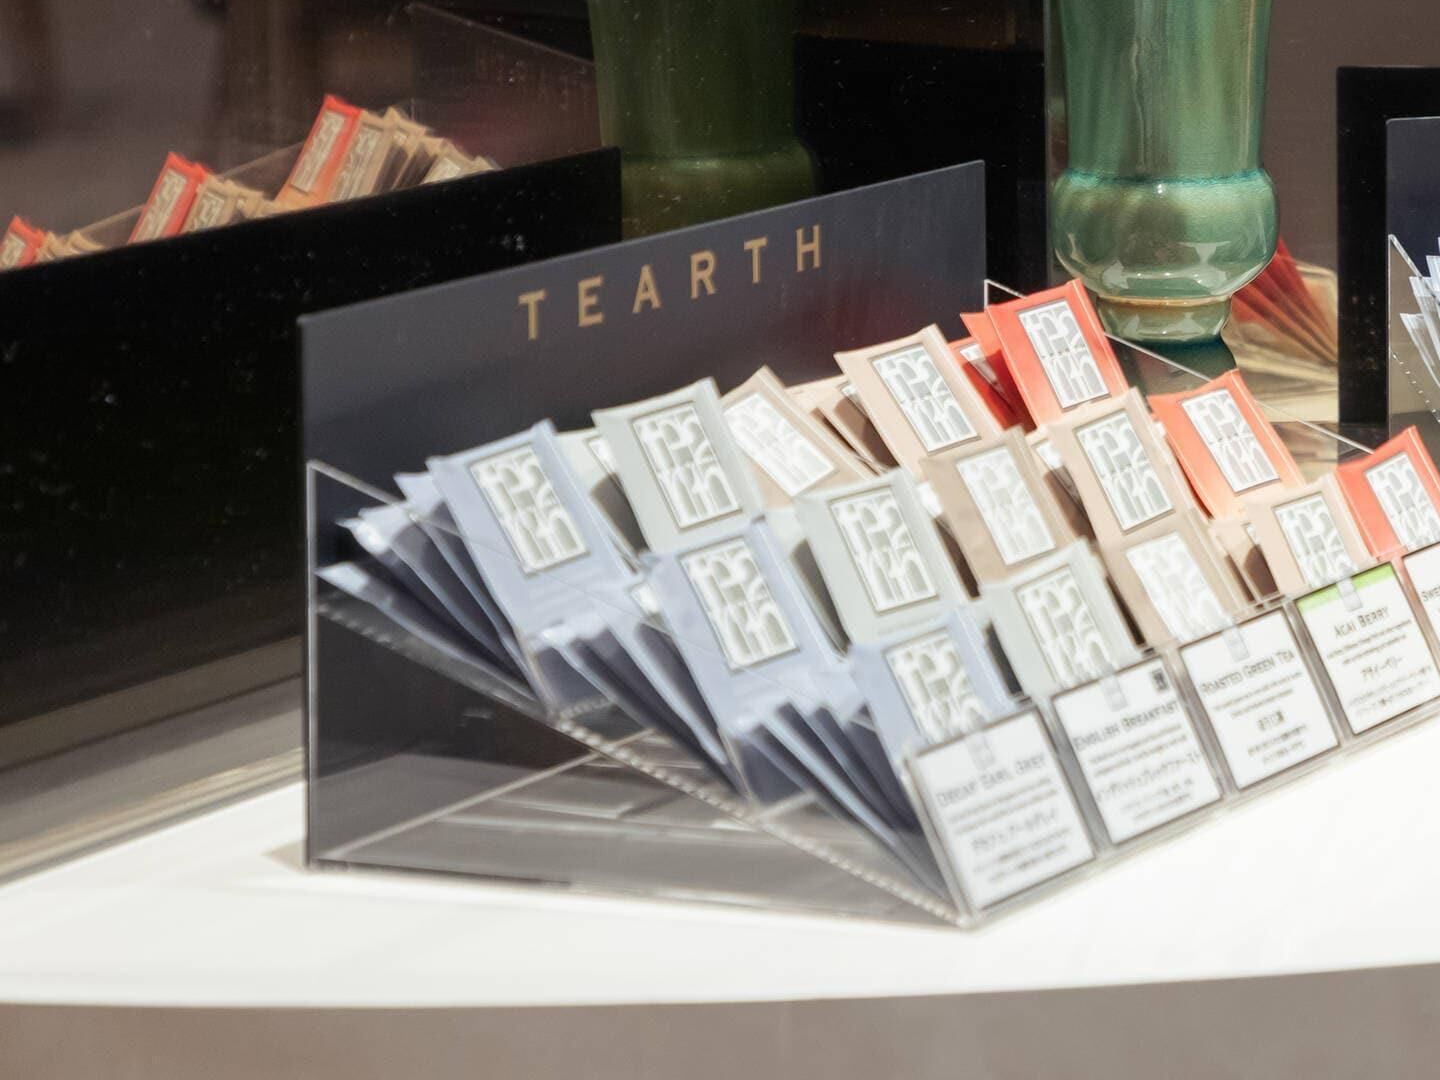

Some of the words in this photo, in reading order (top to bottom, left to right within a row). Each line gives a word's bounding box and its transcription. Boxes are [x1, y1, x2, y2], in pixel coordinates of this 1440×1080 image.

[518, 224, 821, 340] TEARTH
[1334, 622, 1357, 638] ACAI
[1357, 606, 1391, 627] BERRY
[1244, 657, 1276, 677] GREEN
[1275, 649, 1296, 665] TEA
